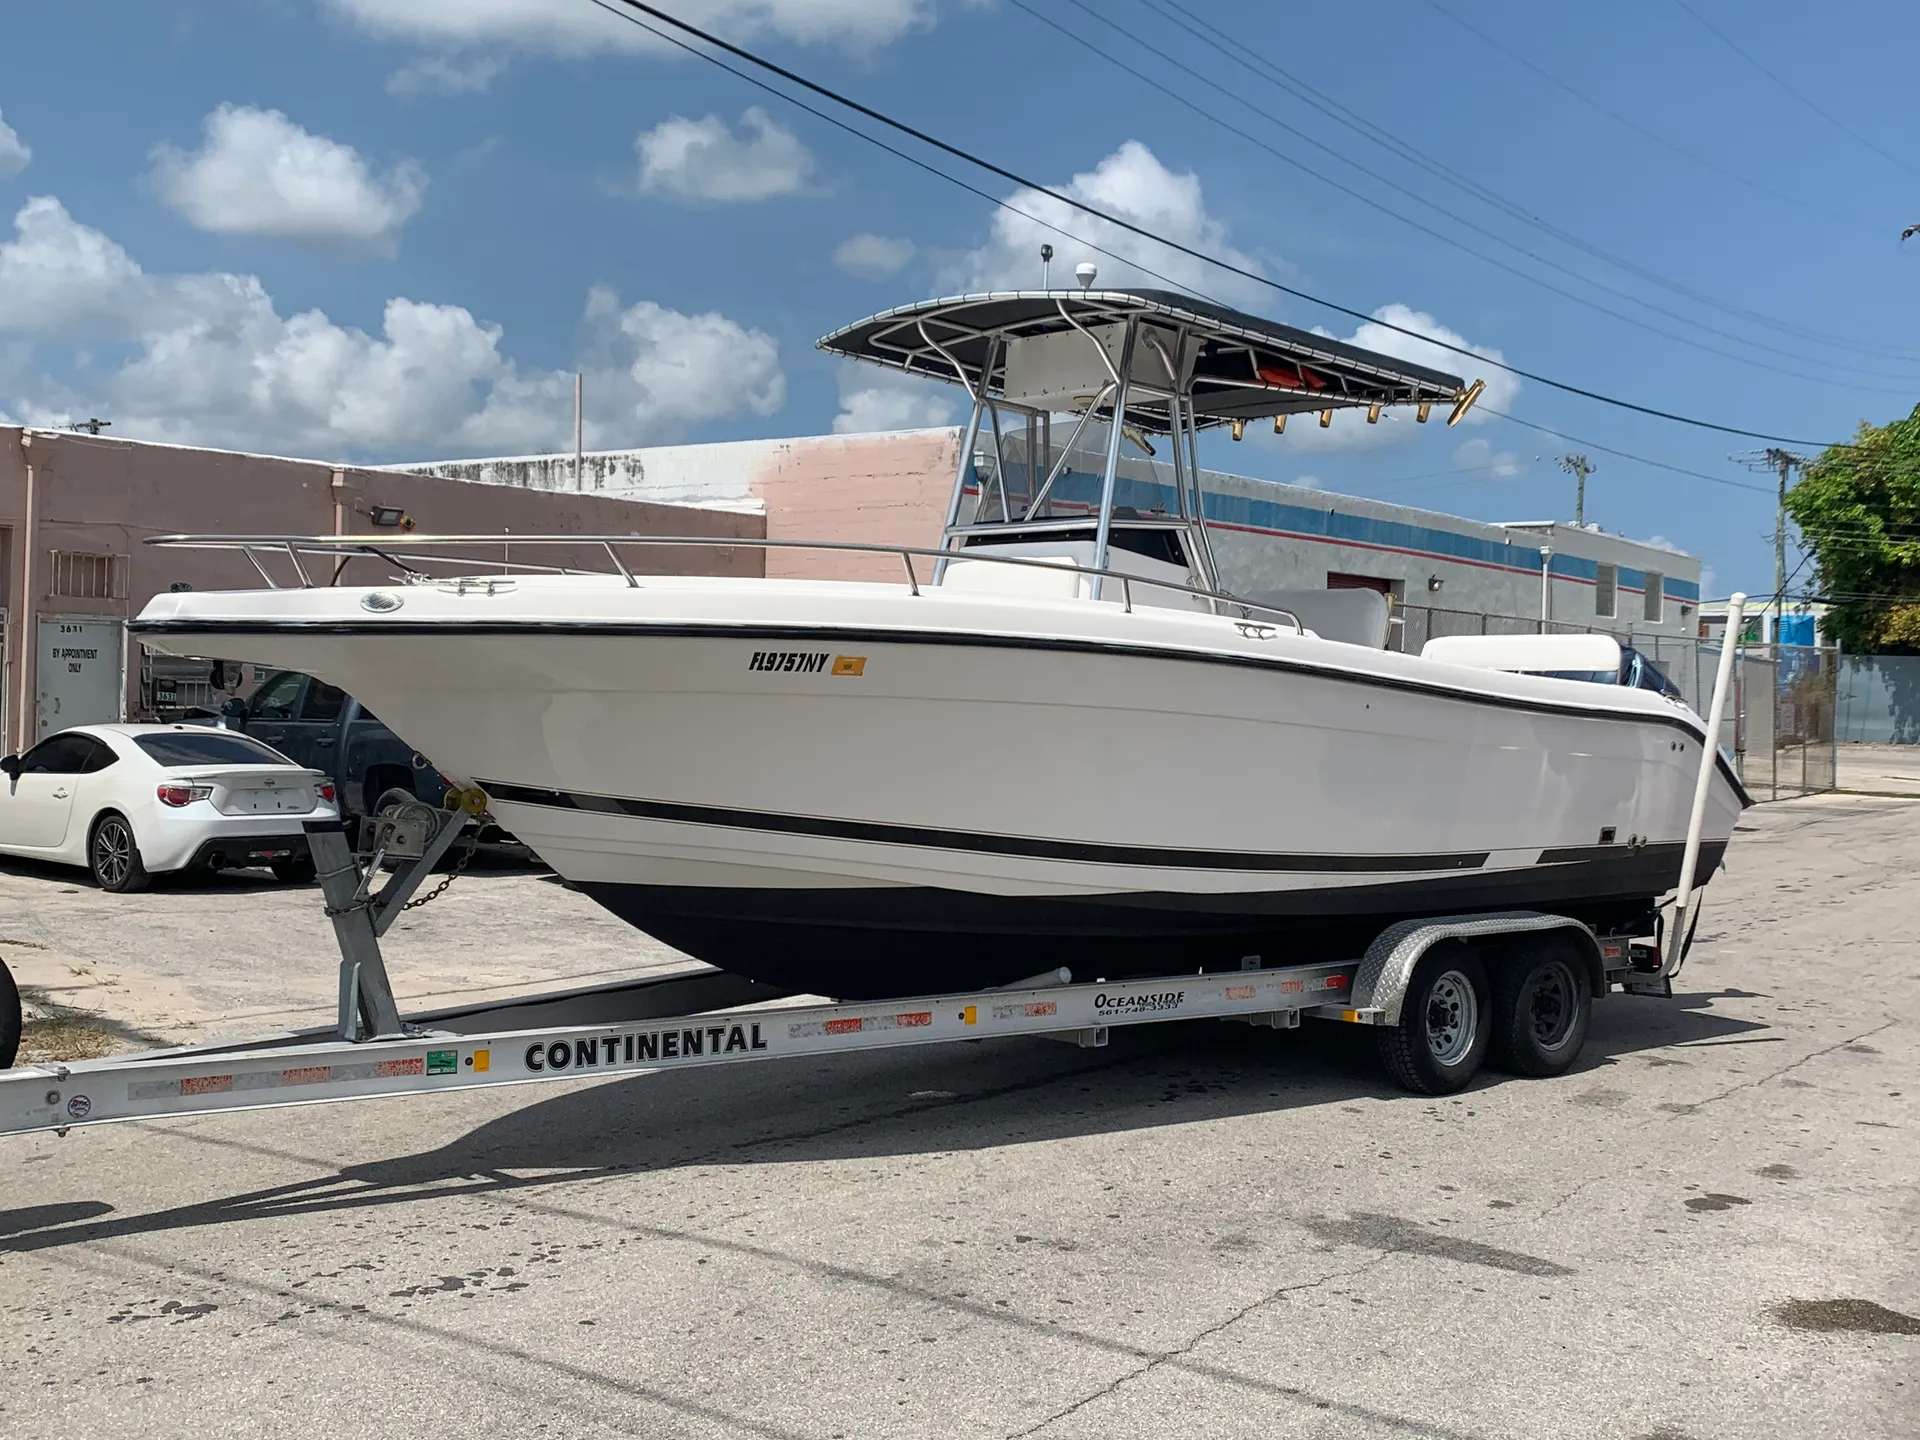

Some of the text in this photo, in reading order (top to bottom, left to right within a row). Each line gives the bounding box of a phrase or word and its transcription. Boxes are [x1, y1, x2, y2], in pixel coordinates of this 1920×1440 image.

[60, 624, 83, 633] 3631
[52, 648, 98, 660] BY APPOINTMENT
[68, 662, 82, 673] ONLY
[748, 651, 830, 673] FL9757NY
[524, 1023, 768, 1072] CONTINENTAL
